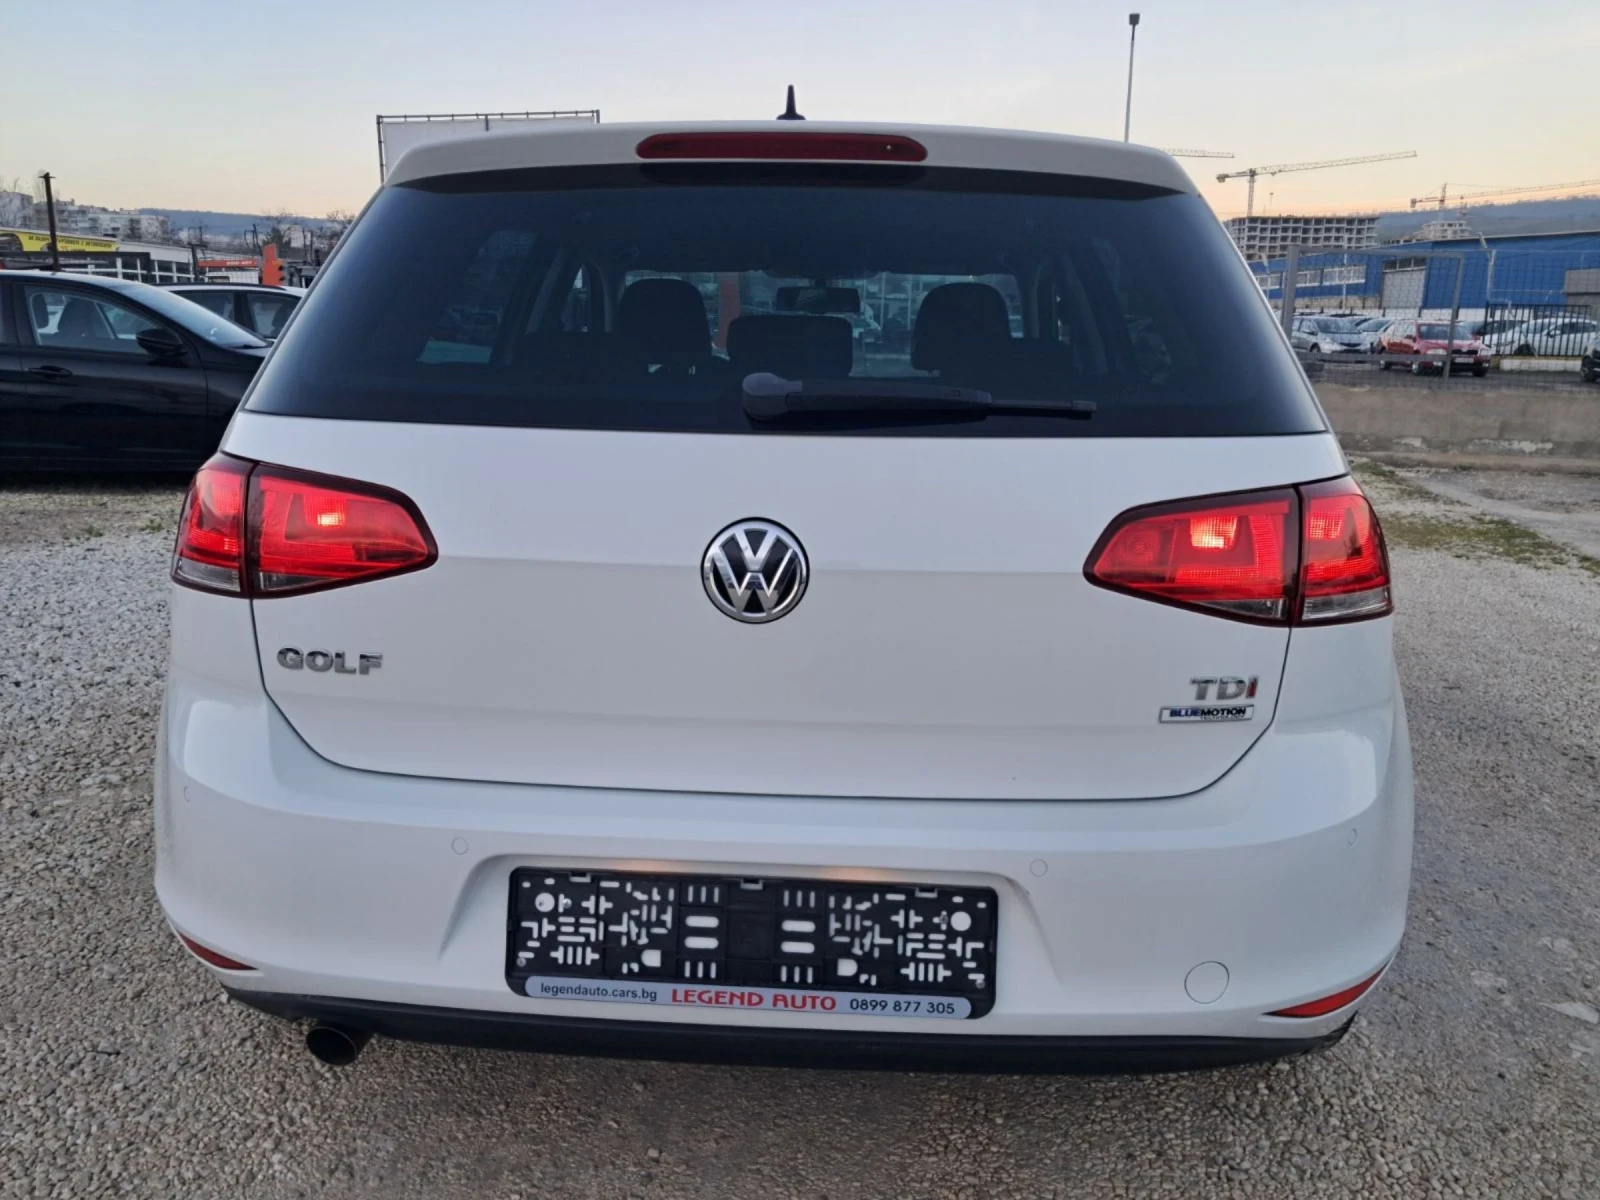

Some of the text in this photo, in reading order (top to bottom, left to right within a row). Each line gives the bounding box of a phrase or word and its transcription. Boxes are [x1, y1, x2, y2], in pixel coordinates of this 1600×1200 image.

[276, 646, 383, 676] GOLF
[1189, 675, 1259, 701] TDI
[540, 982, 658, 1001] legendauto.cars.bg
[671, 988, 837, 1011] LEGEND AUTO
[849, 998, 955, 1015] 0899 877 305
